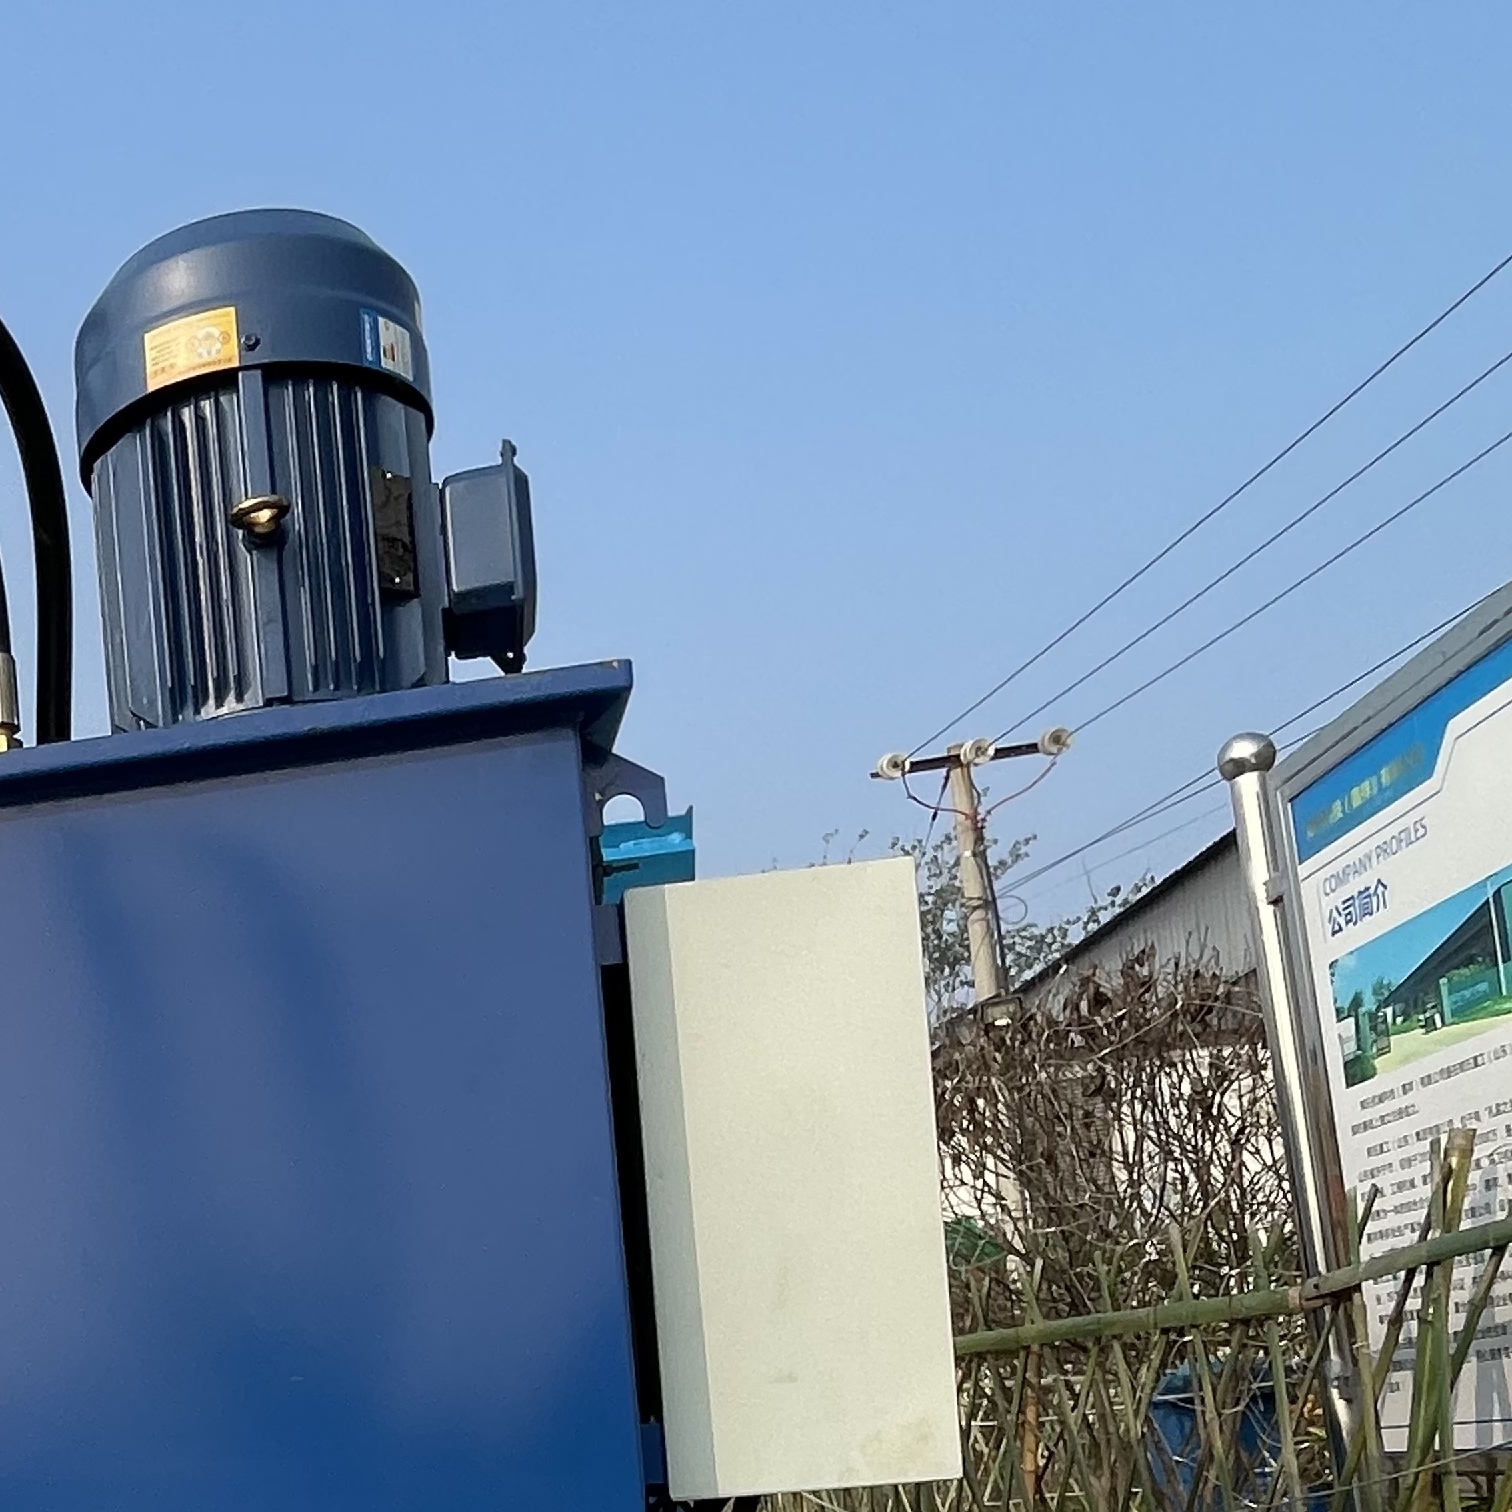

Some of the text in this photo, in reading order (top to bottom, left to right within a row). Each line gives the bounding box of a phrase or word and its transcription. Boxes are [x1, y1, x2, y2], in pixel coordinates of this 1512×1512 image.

[1323, 853, 1372, 897] COMPANY
[1375, 817, 1428, 865] PROFILES
[1328, 879, 1388, 937] 公司简介
